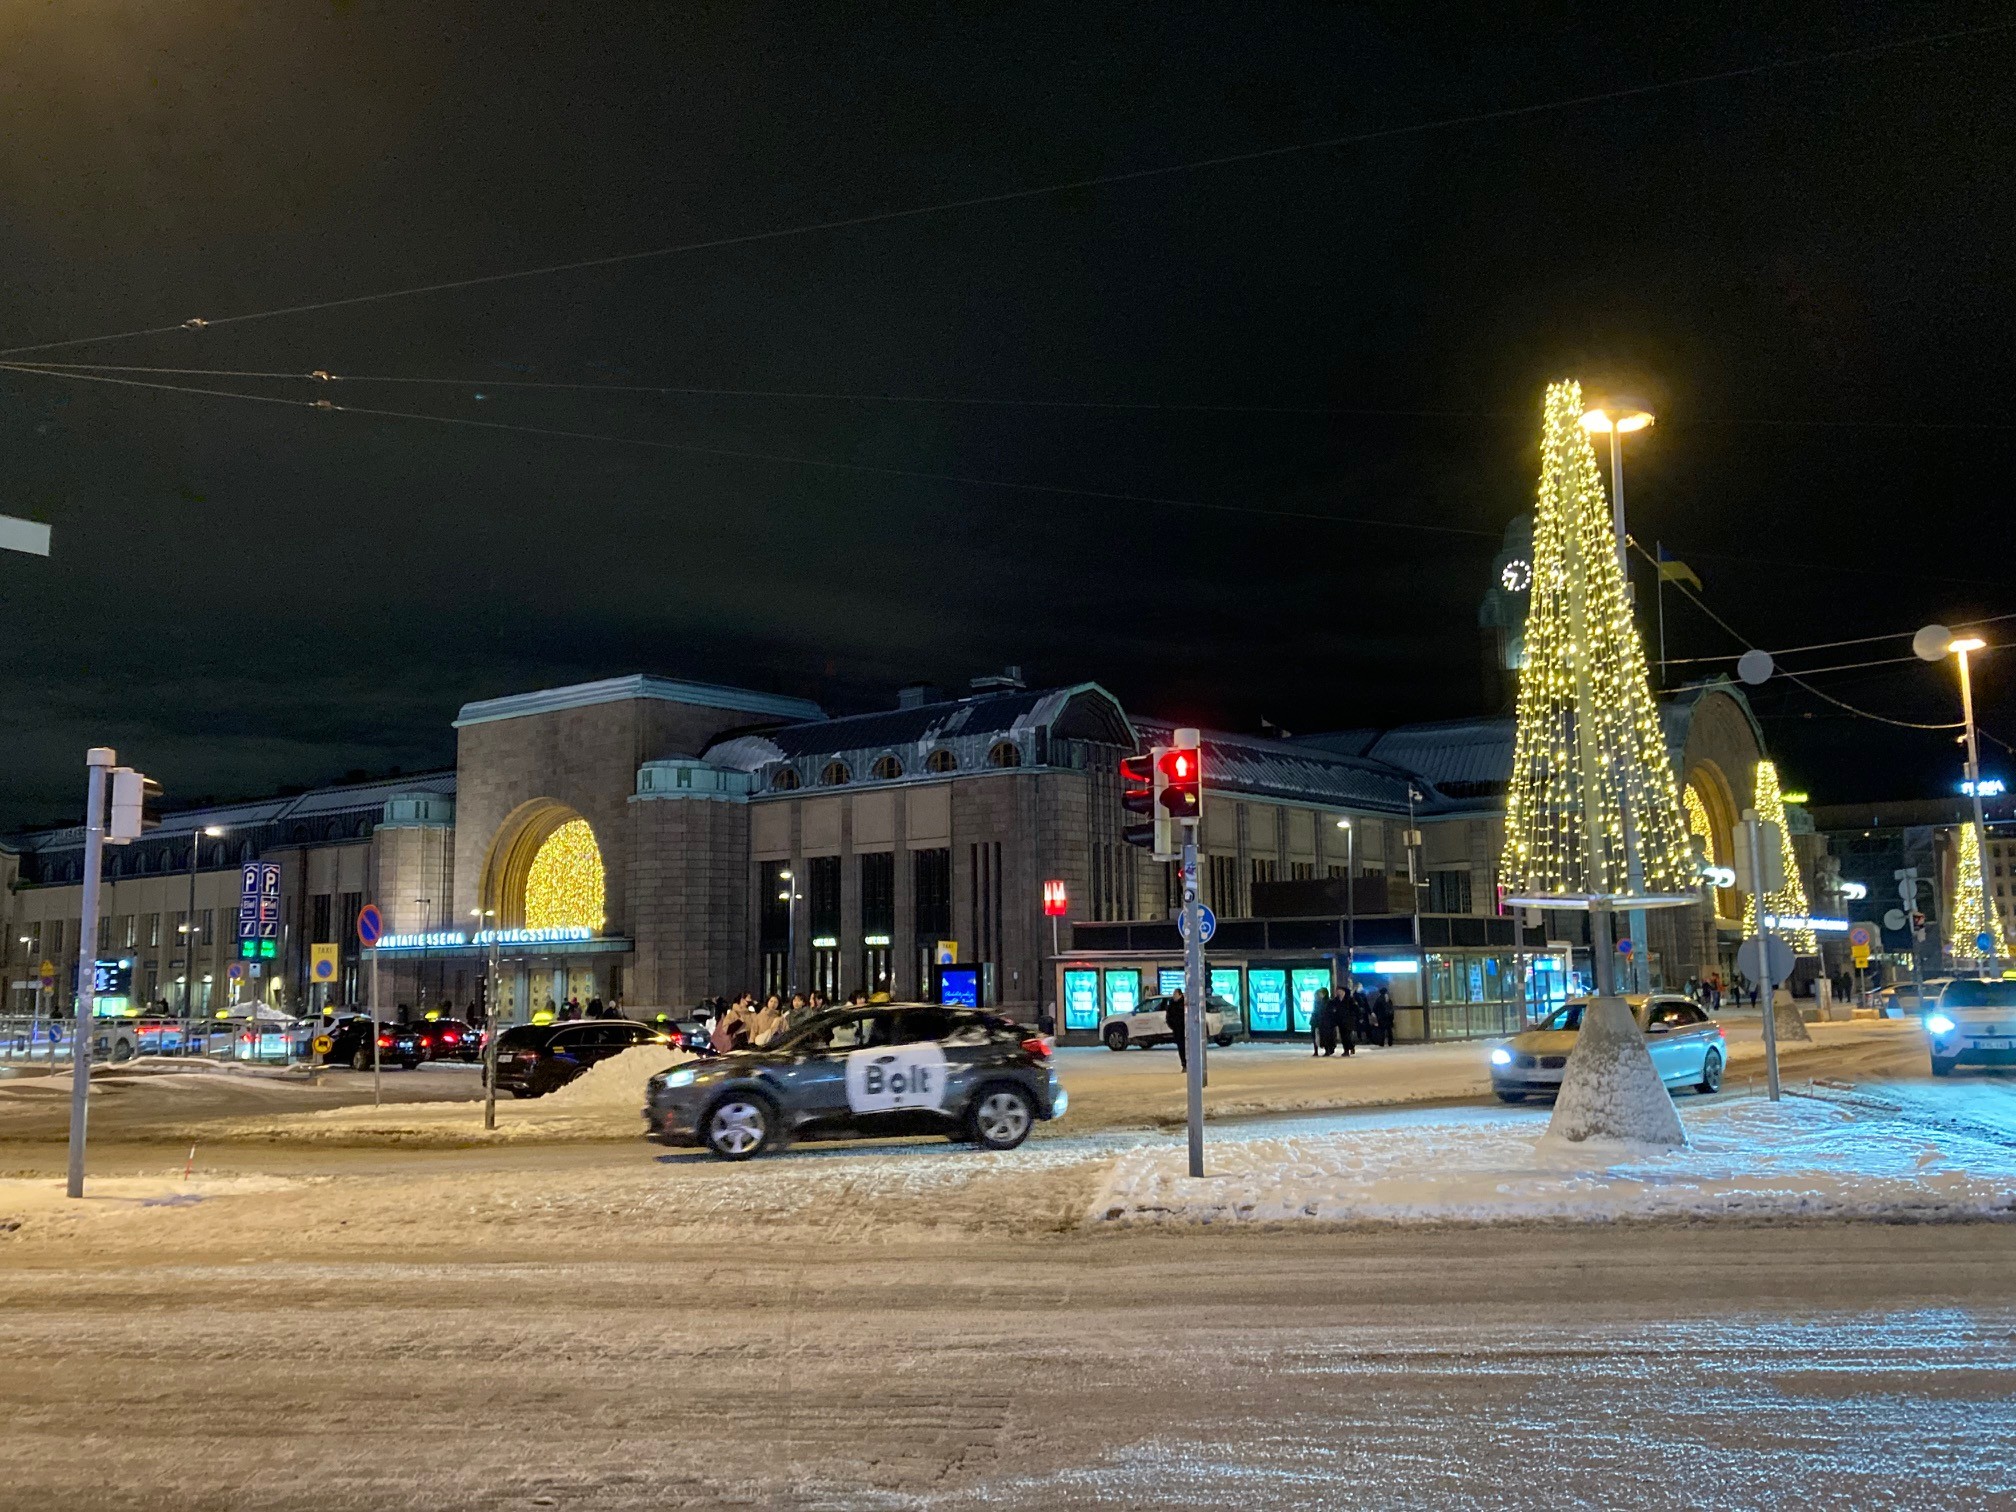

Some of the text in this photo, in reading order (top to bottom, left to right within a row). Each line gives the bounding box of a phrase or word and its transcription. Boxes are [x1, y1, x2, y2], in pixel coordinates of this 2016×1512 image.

[245, 872, 255, 892] P
[265, 872, 276, 892] P
[317, 946, 332, 954] TAXI
[865, 1064, 931, 1103] Bolt
